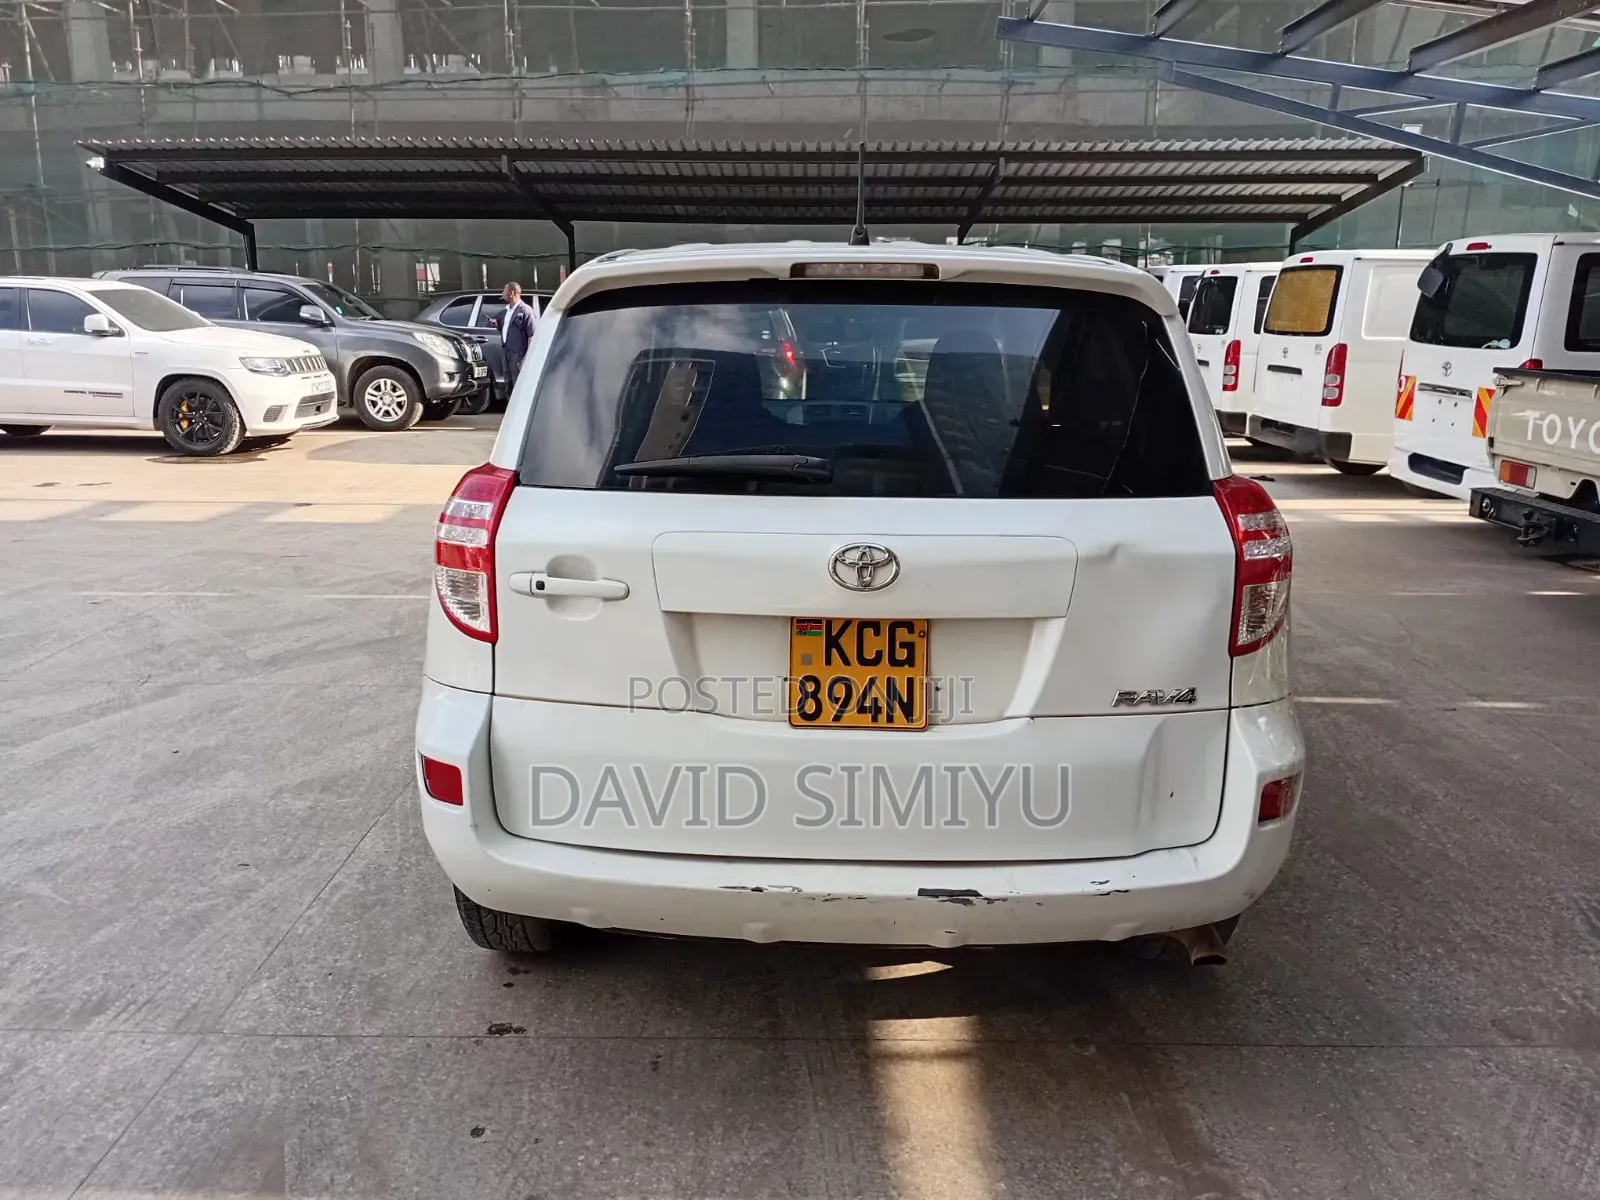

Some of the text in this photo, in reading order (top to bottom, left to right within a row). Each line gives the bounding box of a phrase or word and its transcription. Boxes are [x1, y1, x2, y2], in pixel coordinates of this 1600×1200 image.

[824, 620, 916, 668] KCG
[797, 674, 915, 724] 894N
[1112, 687, 1198, 708] RAV4
